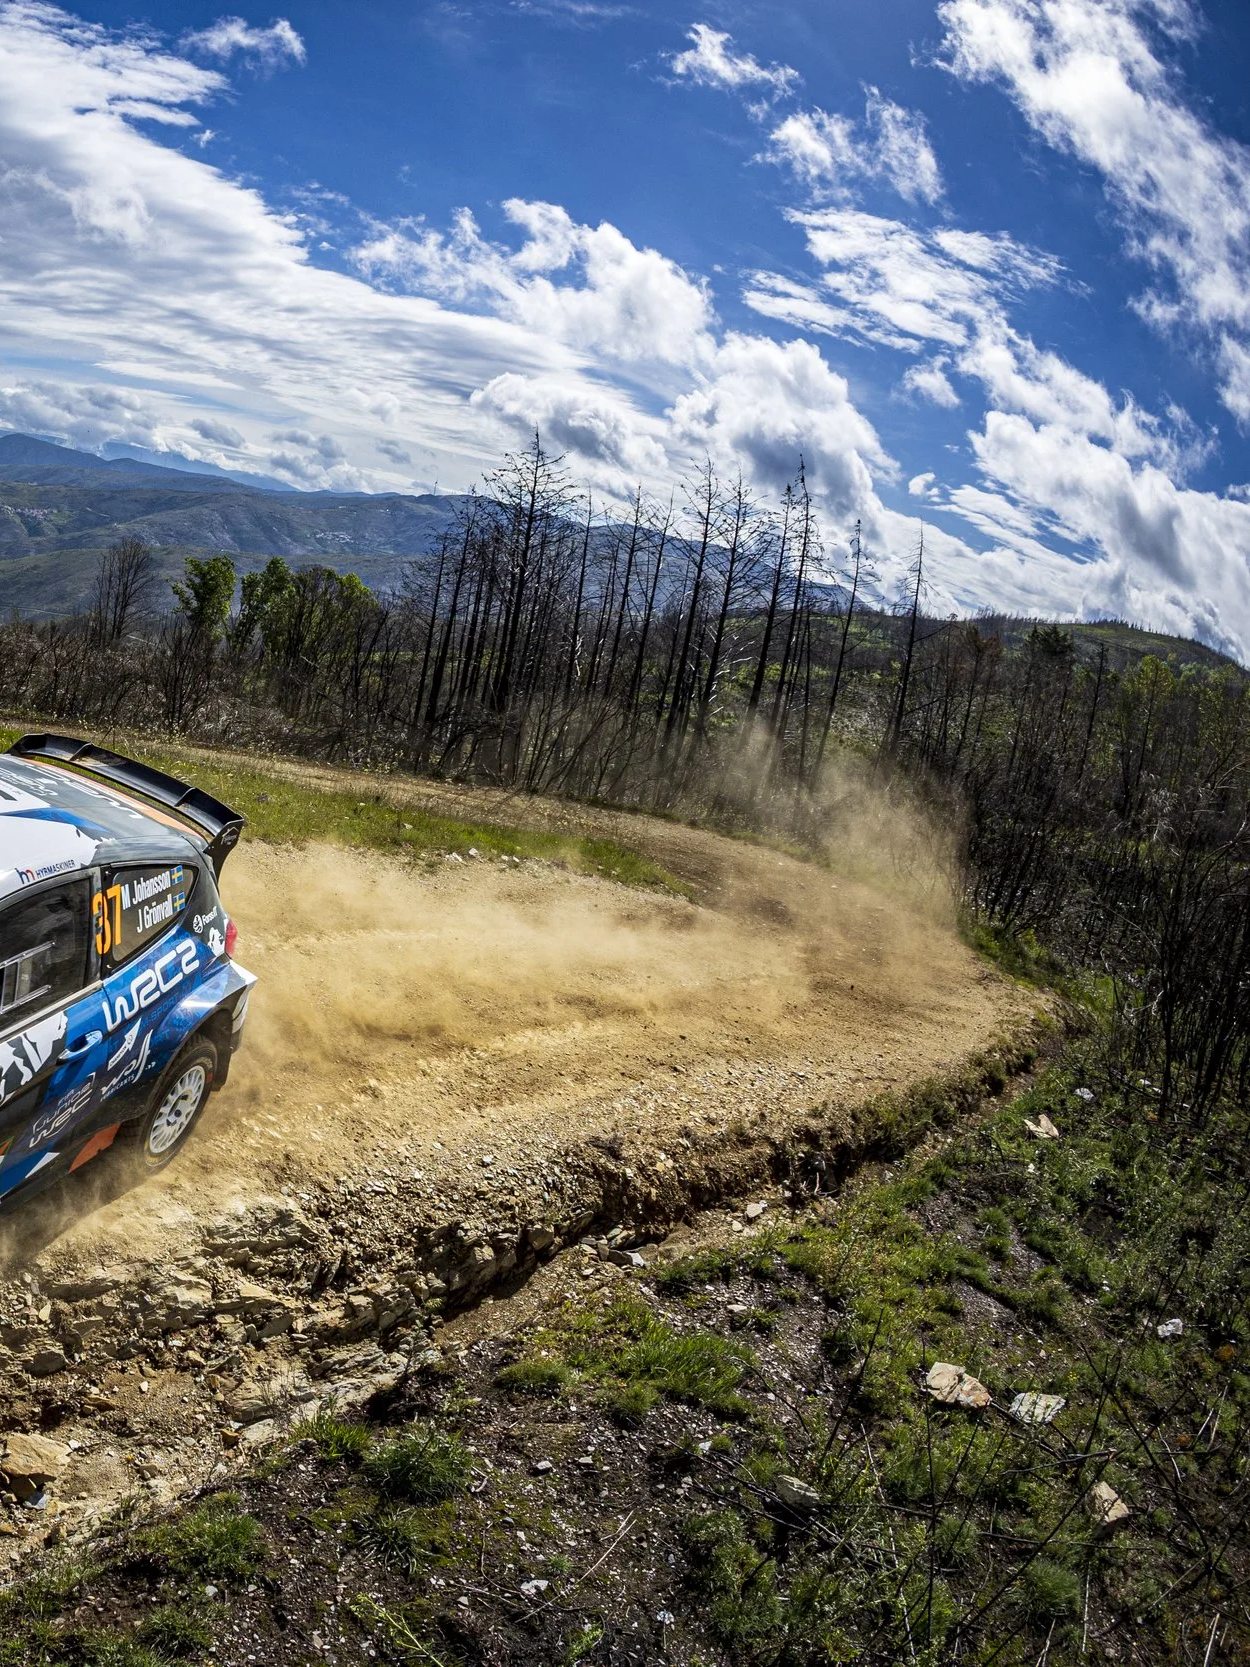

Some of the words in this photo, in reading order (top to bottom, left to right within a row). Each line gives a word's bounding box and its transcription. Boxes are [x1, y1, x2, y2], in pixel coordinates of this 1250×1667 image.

[36, 859, 75, 880] HYRMASKINER
[121, 885, 131, 910] M
[132, 872, 171, 905] Johansson
[92, 884, 123, 955] 37
[137, 905, 145, 934] J
[144, 893, 174, 929] Grönvall
[103, 940, 200, 1032] WRC2
[29, 1089, 93, 1148] WRC
